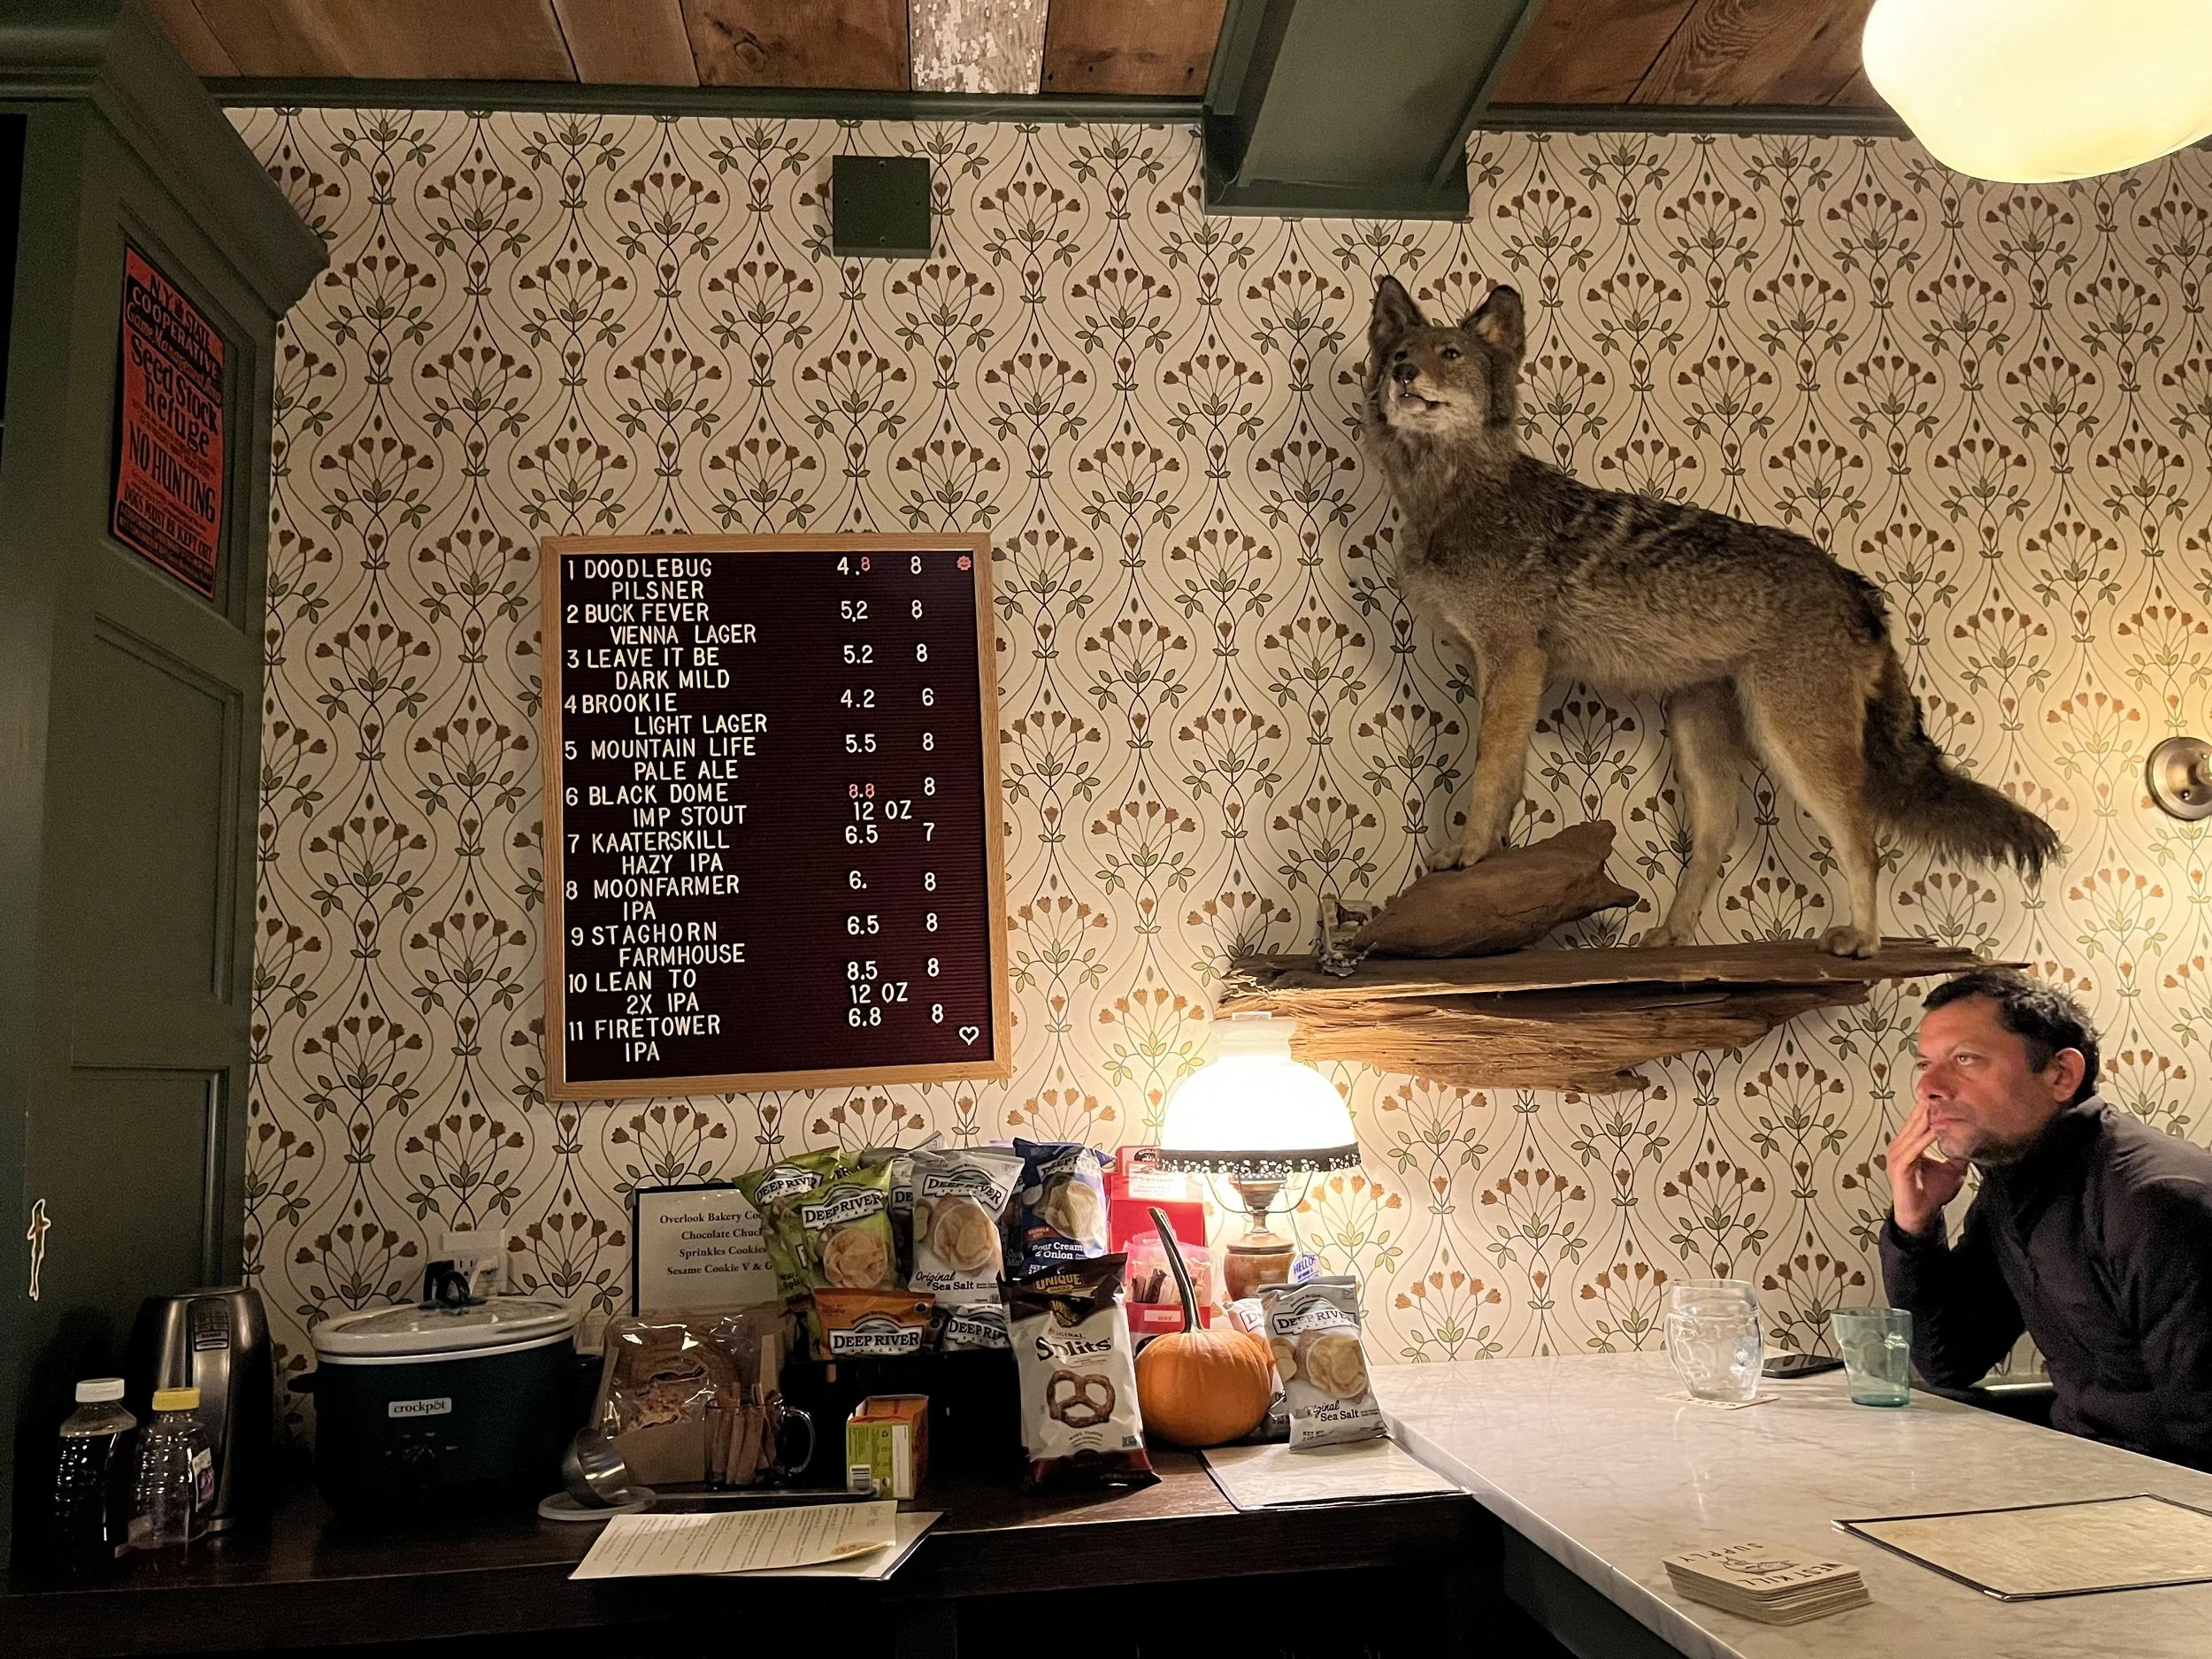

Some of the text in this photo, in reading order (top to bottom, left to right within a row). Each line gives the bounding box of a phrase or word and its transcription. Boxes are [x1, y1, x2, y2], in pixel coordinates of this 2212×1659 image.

[127, 301, 152, 339] Game
[132, 285, 219, 380] COOPERATIVE
[130, 334, 219, 436] Seed Stock
[144, 374, 210, 458] Refuge
[128, 419, 150, 475] NO
[151, 441, 215, 526] HUNTING
[568, 555, 922, 580] 1 DOODLEBUG 4.8 8
[611, 580, 704, 601] PILSNER
[566, 603, 579, 624] 2
[585, 603, 635, 624] BUCK
[641, 602, 710, 623] FEVER
[911, 599, 923, 620] 8
[610, 623, 757, 646] VIENNA LAGER
[566, 643, 928, 669] 3 LEAVE IT BE 5.2 8
[615, 669, 730, 691] DARK MILD
[564, 687, 934, 714] 4 BROOKIE 4.2 6
[634, 713, 767, 736] LIGHT LAGER
[565, 732, 934, 761] 5 MOUNTAIN LIFE 5.5 8
[634, 759, 739, 781] PALE ALE
[565, 776, 936, 807] 6 BLACK DOME 8.8 8
[633, 799, 912, 828] IMP STOUT 12 OZ
[567, 822, 935, 854] 7 KAATERSKILL 6.5 7
[622, 852, 724, 876] HAZY IPA
[565, 880, 579, 901] 8
[594, 874, 740, 899] MOONFARMER
[924, 872, 937, 892] 8
[623, 900, 657, 922] IPA
[571, 912, 938, 947] 9 STAGHORN 6.5 8
[618, 942, 745, 968] FARMHOUSE
[568, 957, 940, 994] 10 LEAN TO 8.5 8
[626, 981, 909, 1016] 2X IPA 12 OZ
[568, 1002, 944, 1041] 11 FIRETOWER 6.8 8
[625, 1041, 660, 1063] IPA
[895, 1191, 912, 1202] DE
[660, 1213, 704, 1225] Overlook
[708, 1212, 742, 1224] Bakery
[804, 1194, 881, 1223] DEEP RIVER
[681, 1229, 731, 1240] Chocolate
[1053, 1241, 1084, 1251] Cream
[680, 1245, 767, 1260] Sprinkles Cookies
[1043, 1249, 1074, 1260] Onion
[667, 1265, 702, 1275] Sesame
[704, 1263, 739, 1273] Cookie
[916, 1271, 956, 1286] Original
[932, 1282, 951, 1291] Sea
[953, 1281, 974, 1290] Salt
[1035, 1274, 1082, 1291] UNIQUE
[949, 1319, 983, 1335] DEEP
[1277, 1313, 1314, 1329] DEEP
[833, 1332, 919, 1348] DEEP RIVER
[1035, 1337, 1111, 1361] Splits
[394, 1400, 445, 1414] crockpot
[1320, 1412, 1338, 1422] Sea
[1340, 1409, 1359, 1419] Salt
[1678, 1542, 1764, 1563] SUPPLY
[1737, 1562, 1843, 1586] WEST KILL
